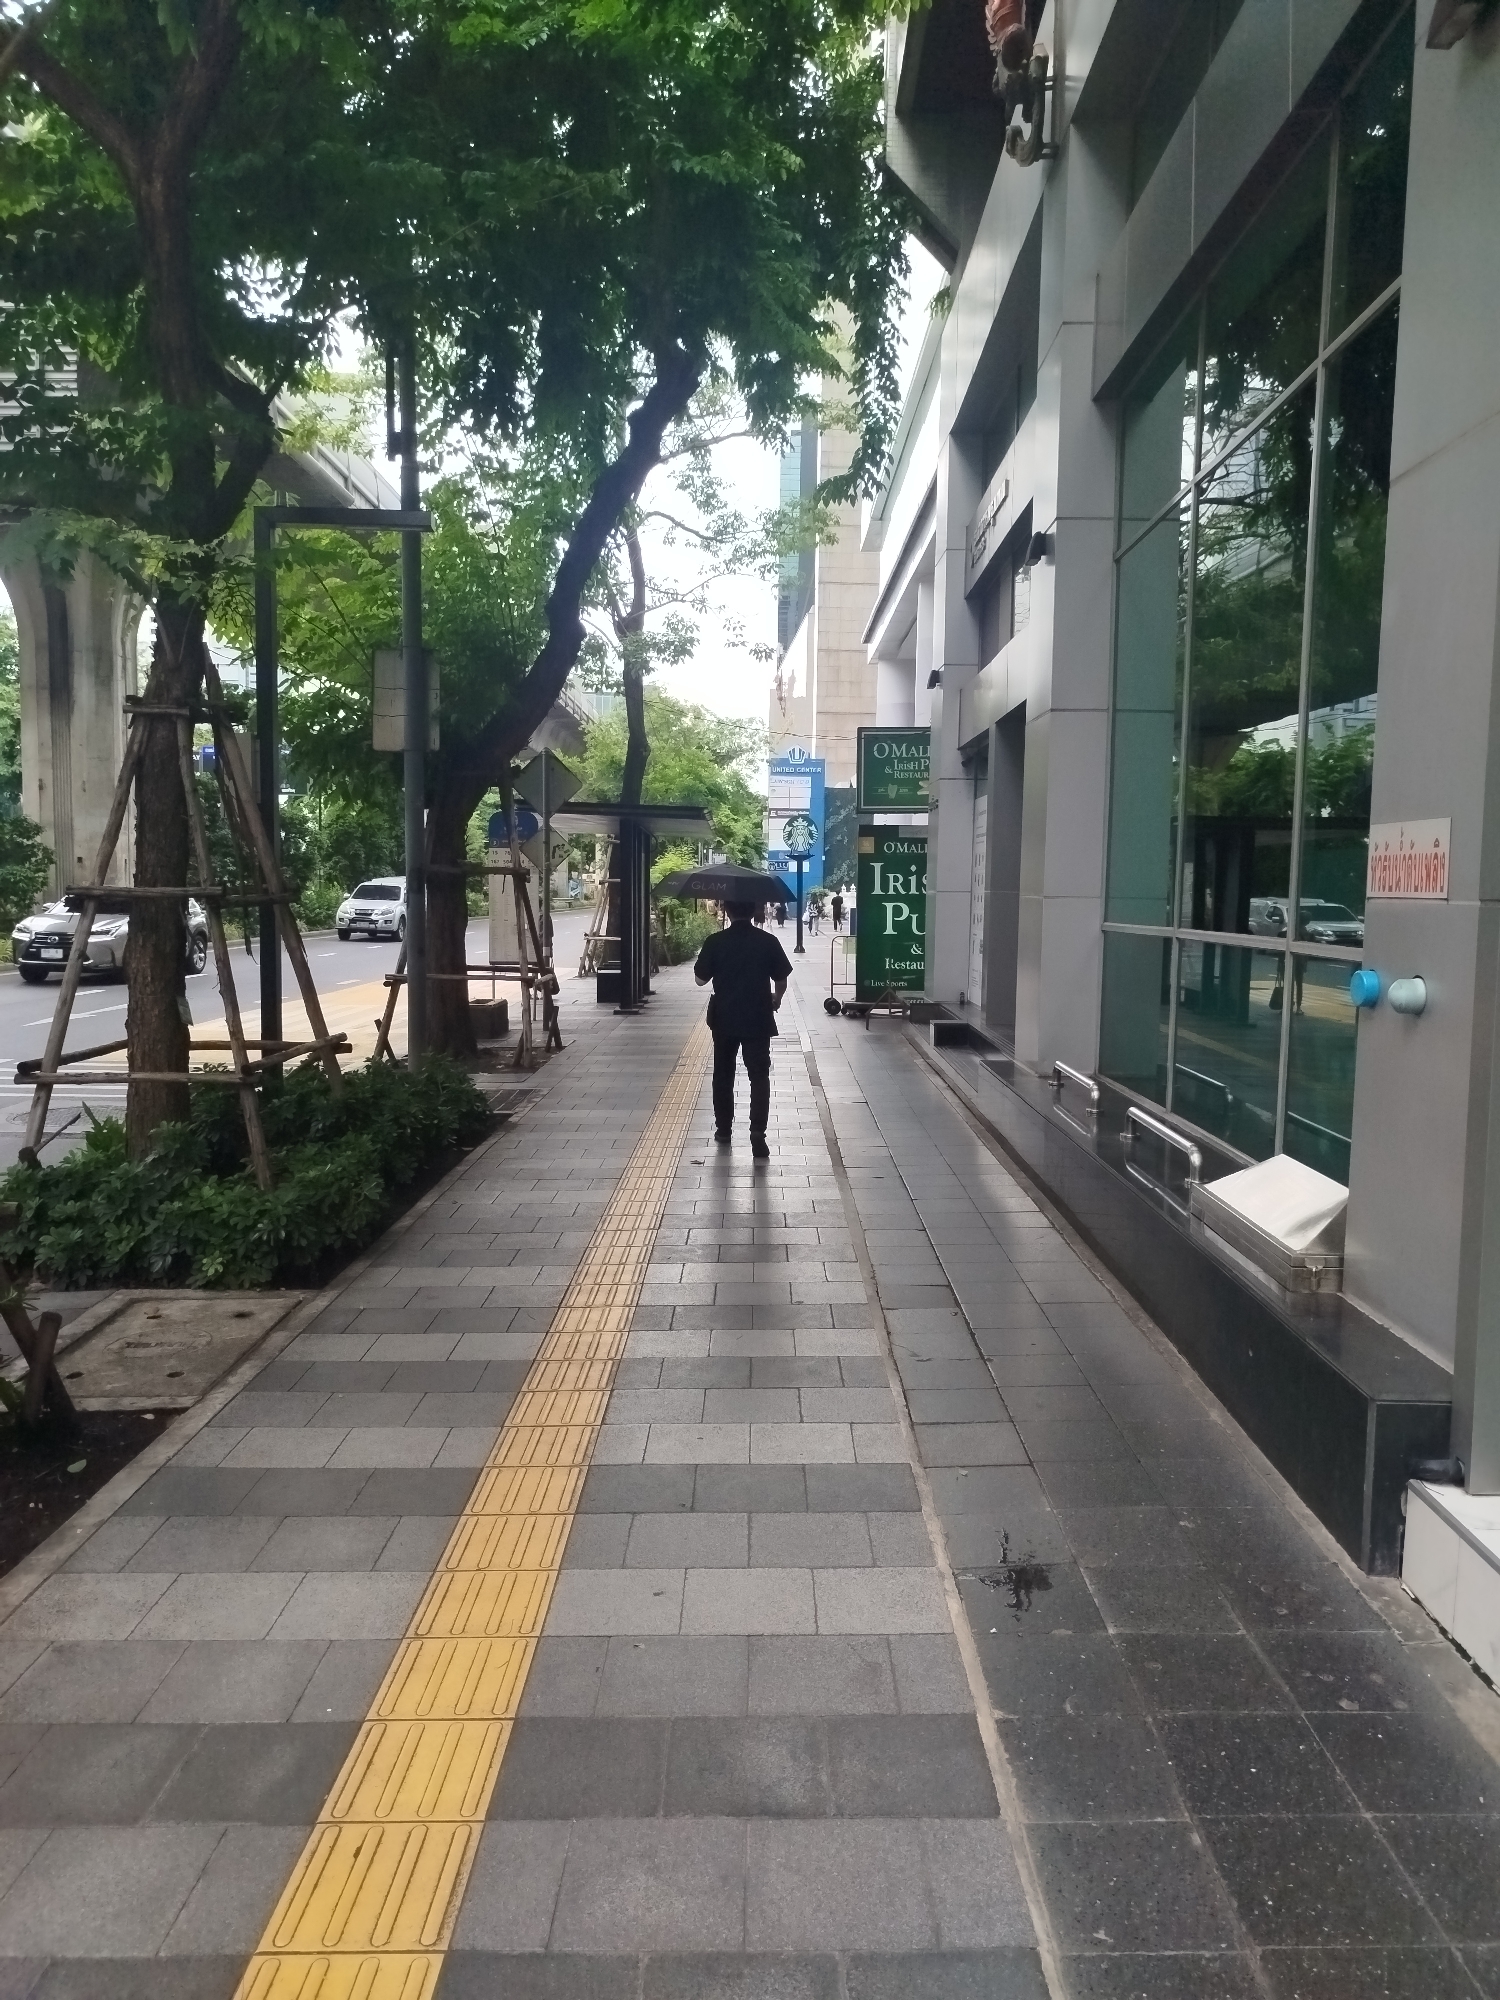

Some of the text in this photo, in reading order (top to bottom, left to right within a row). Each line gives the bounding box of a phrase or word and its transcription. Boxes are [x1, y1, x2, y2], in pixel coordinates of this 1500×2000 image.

[884, 766, 893, 774] &
[691, 881, 727, 891] GLAM
[910, 943, 924, 955] &
[886, 980, 908, 988] Sports
